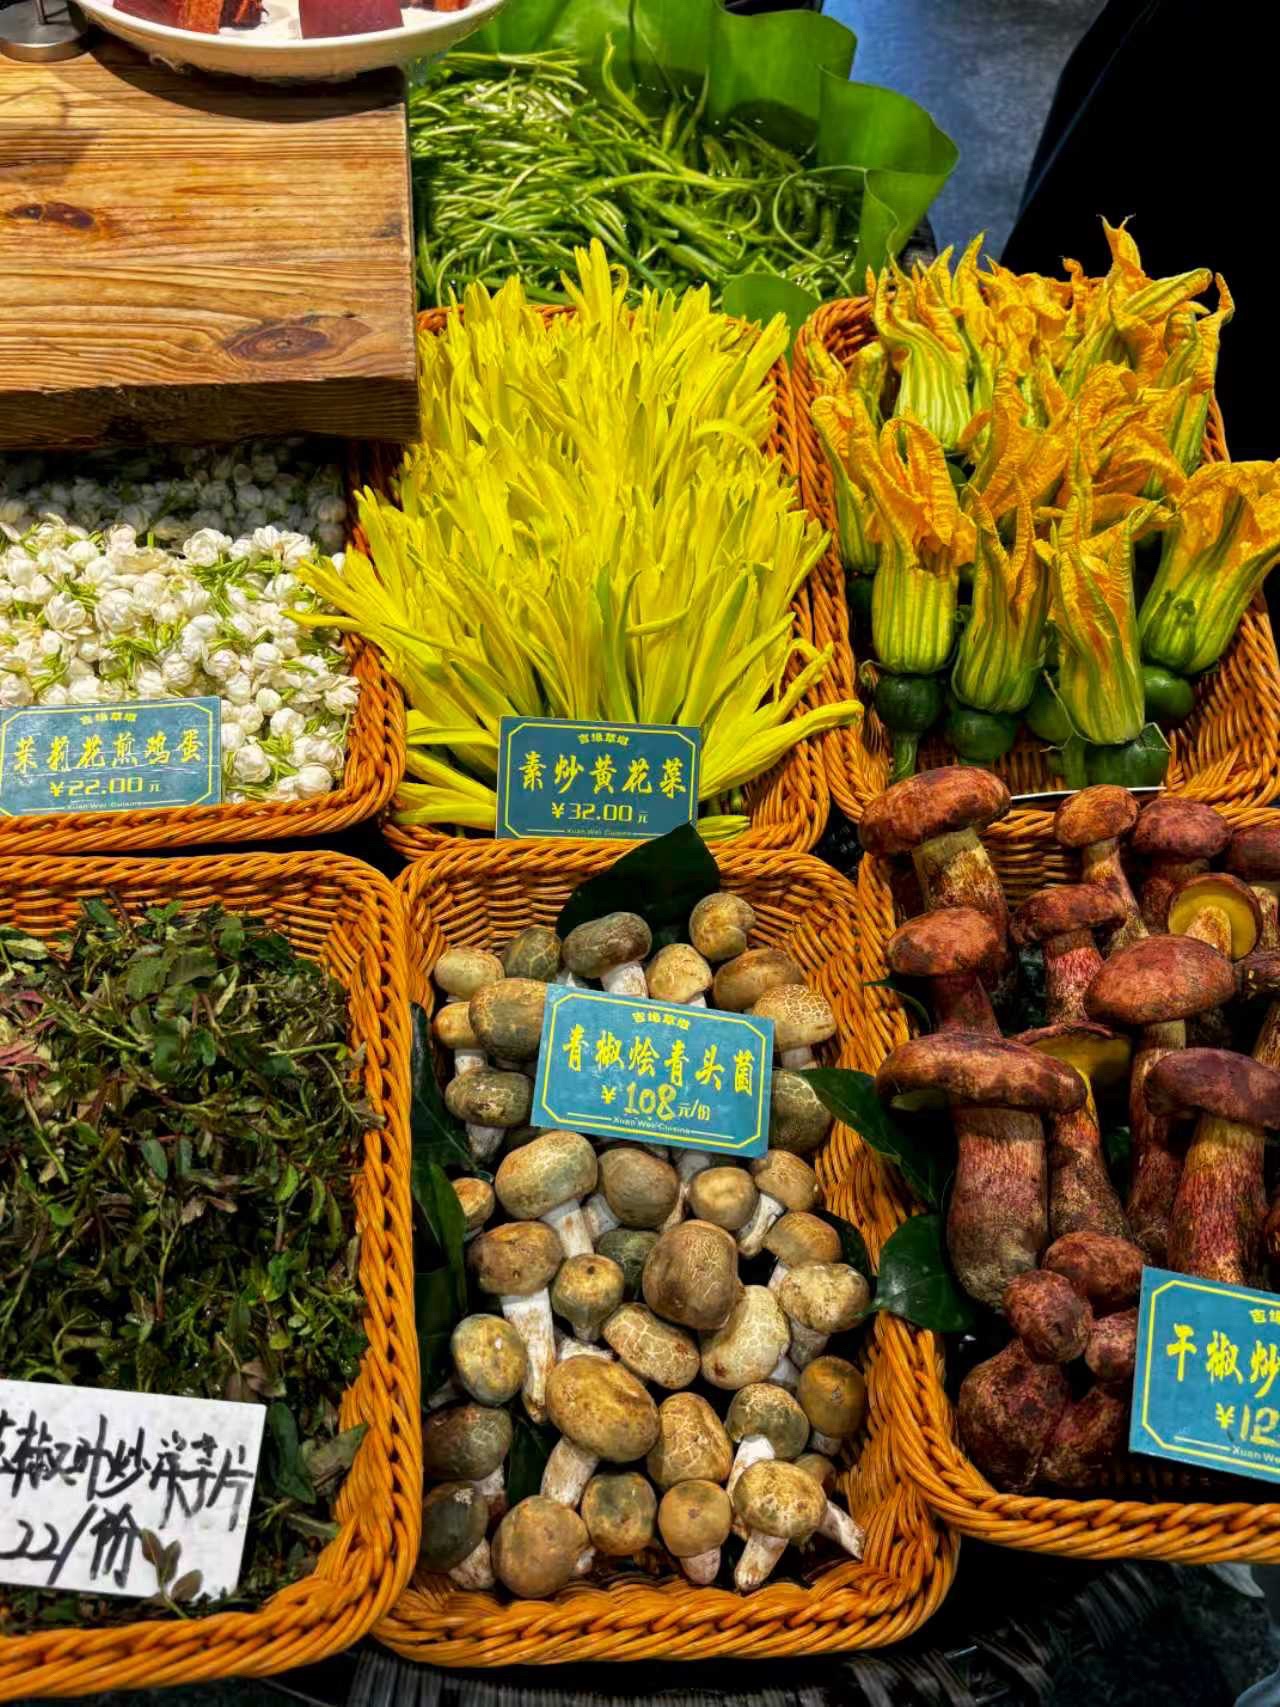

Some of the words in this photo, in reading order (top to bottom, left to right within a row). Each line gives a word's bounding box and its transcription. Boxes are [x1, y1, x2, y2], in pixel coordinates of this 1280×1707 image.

[14, 727, 204, 776] 茉莉花煎鸡蛋
[518, 750, 686, 799] 素炒黄花菜
[562, 1023, 755, 1096] 青椒烩青头菌
[1231, 1444, 1262, 1460] Xuan
